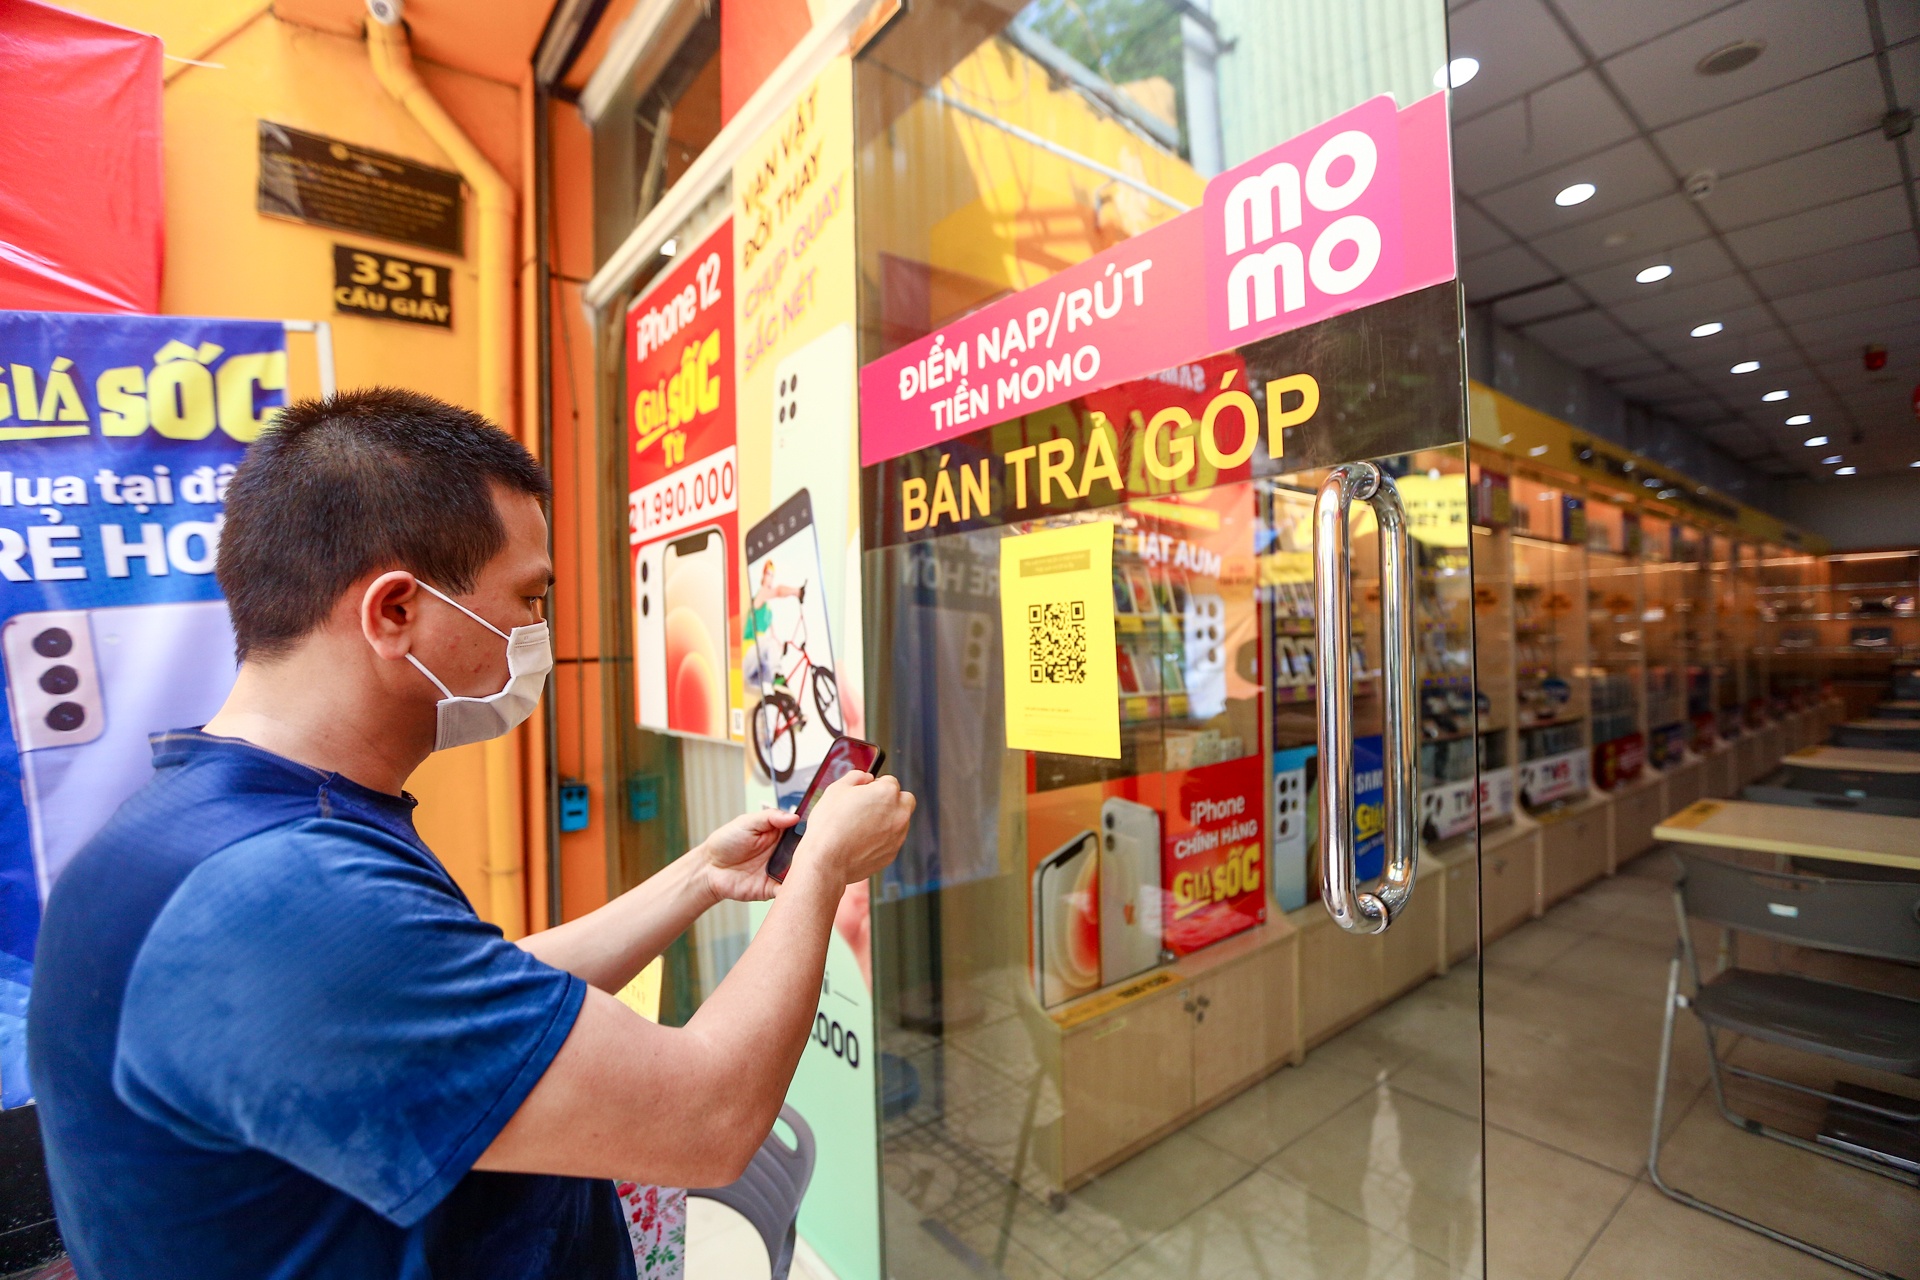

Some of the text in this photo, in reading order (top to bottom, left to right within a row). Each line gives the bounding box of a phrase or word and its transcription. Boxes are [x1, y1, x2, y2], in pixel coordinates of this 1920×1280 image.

[777, 141, 823, 223] THAY
[792, 171, 844, 260] QUAY
[350, 253, 437, 297] 351
[637, 252, 721, 362] iPhone 12
[899, 258, 1152, 400] ĐIỂM NẠP/RÚT
[0, 339, 287, 443] IÁ SỐC
[634, 329, 720, 436] GIÁ SỐC
[930, 378, 989, 431] TIỀN
[997, 345, 1101, 409] MOMO
[94, 465, 173, 514] tại
[902, 369, 1320, 533] BÁN TRẢ GÓP
[629, 461, 734, 533] 21.990.000
[1174, 819, 1258, 859] CHÍNH HÀNG
[1190, 795, 1245, 827] iPhone
[1173, 842, 1260, 906] GIÁ SỐC
